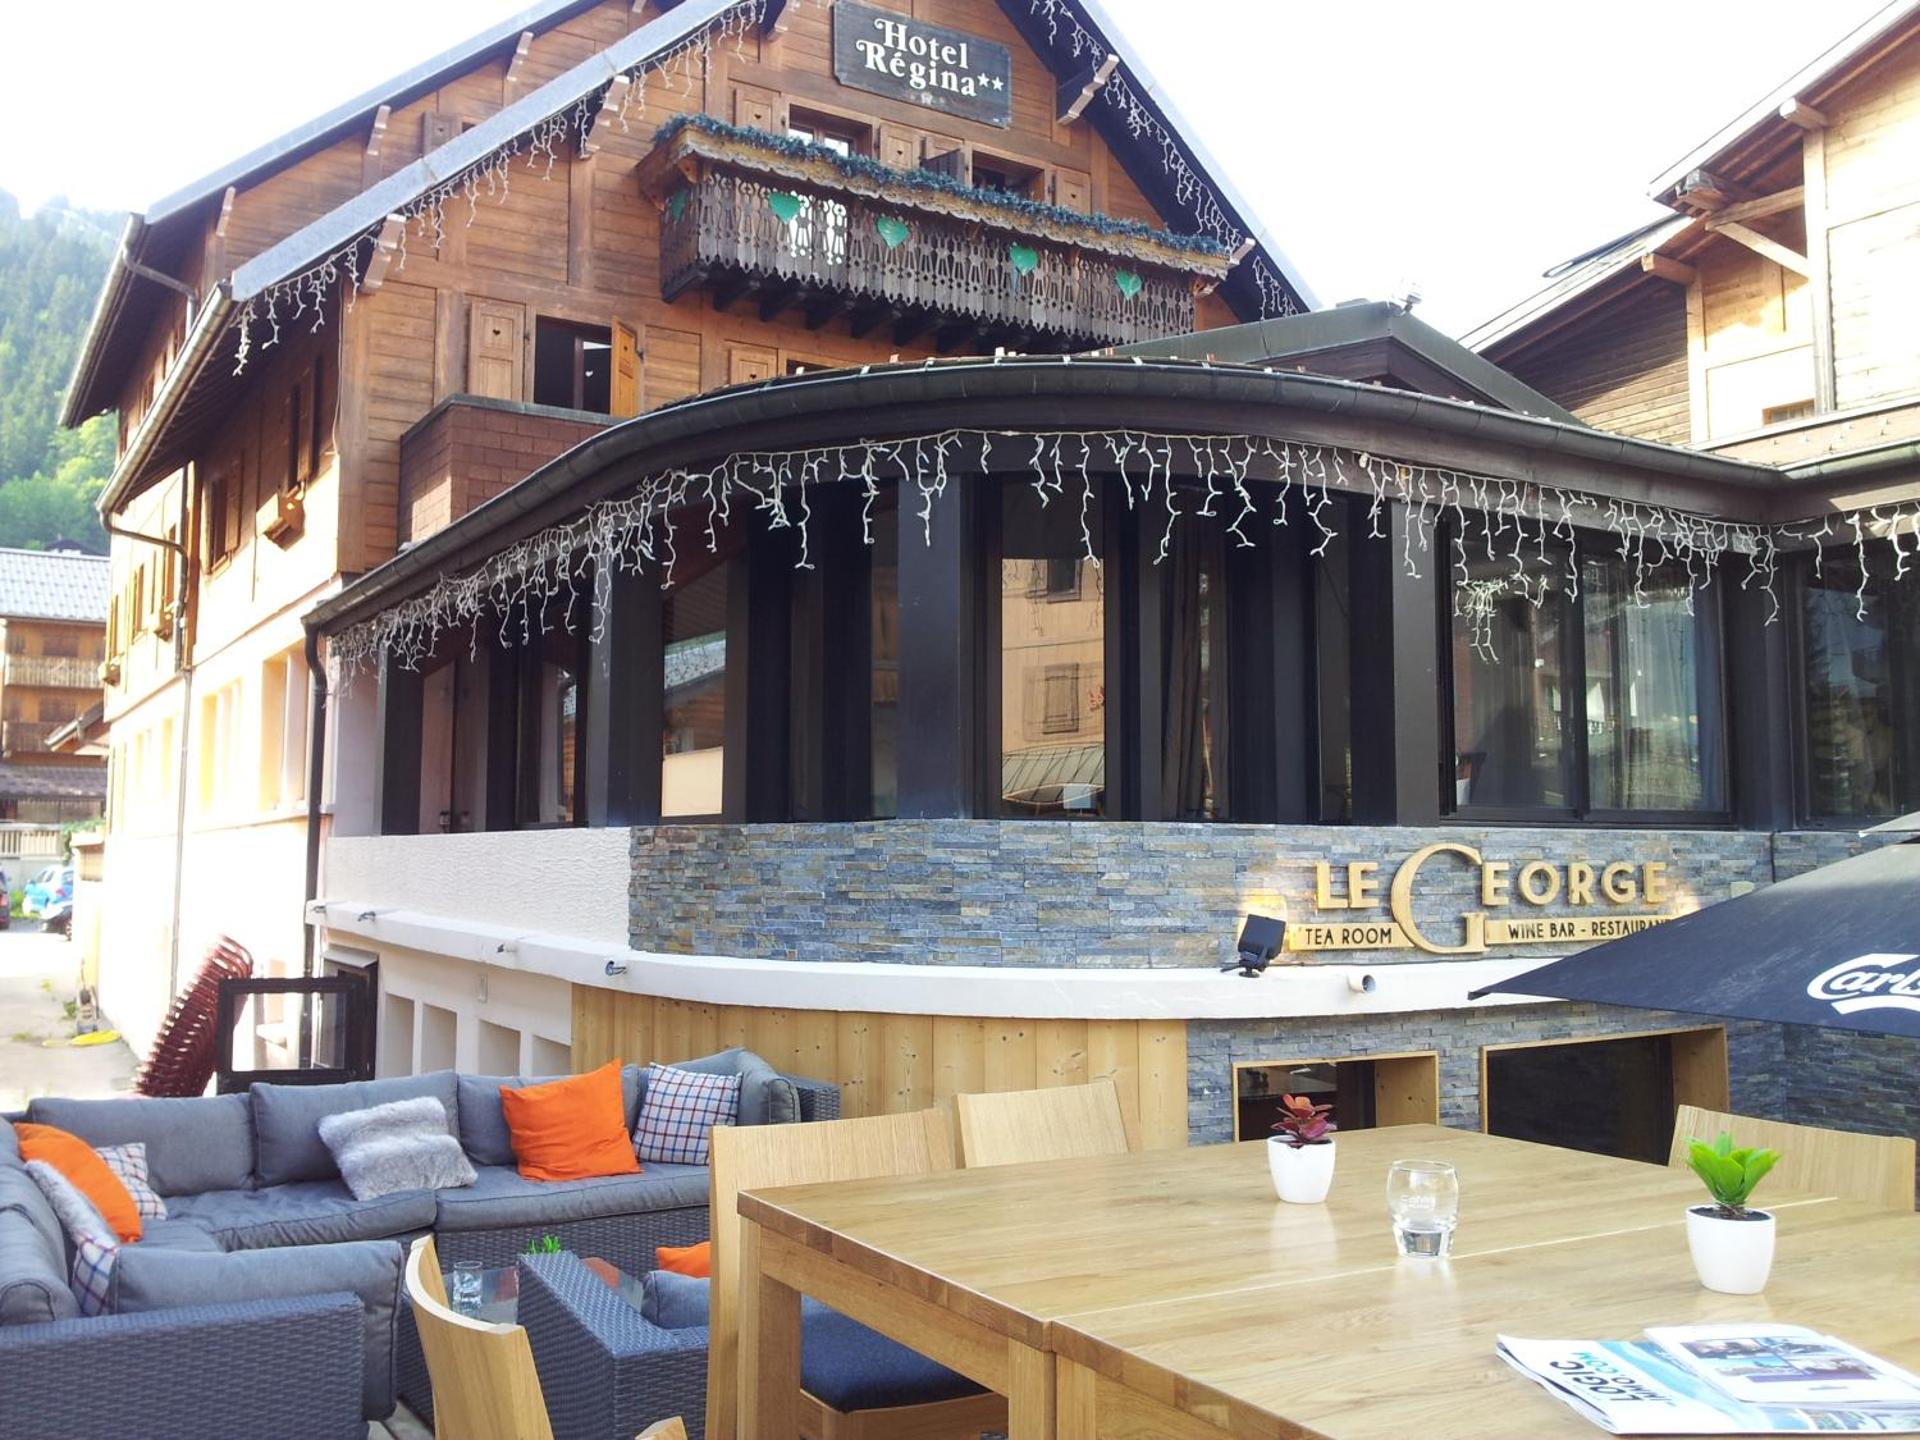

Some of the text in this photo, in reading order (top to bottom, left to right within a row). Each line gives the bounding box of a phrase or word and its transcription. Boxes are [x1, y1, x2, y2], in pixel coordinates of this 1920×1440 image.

[874, 18, 969, 69] Hotel
[855, 39, 977, 97] Régina
[1315, 842, 1669, 954] LE GEORGE
[1305, 927, 1392, 945] TEA ROOM
[1508, 923, 1544, 939] WINE
[1549, 922, 1575, 938] BAR
[1549, 1360, 1645, 1401] LOGIC
